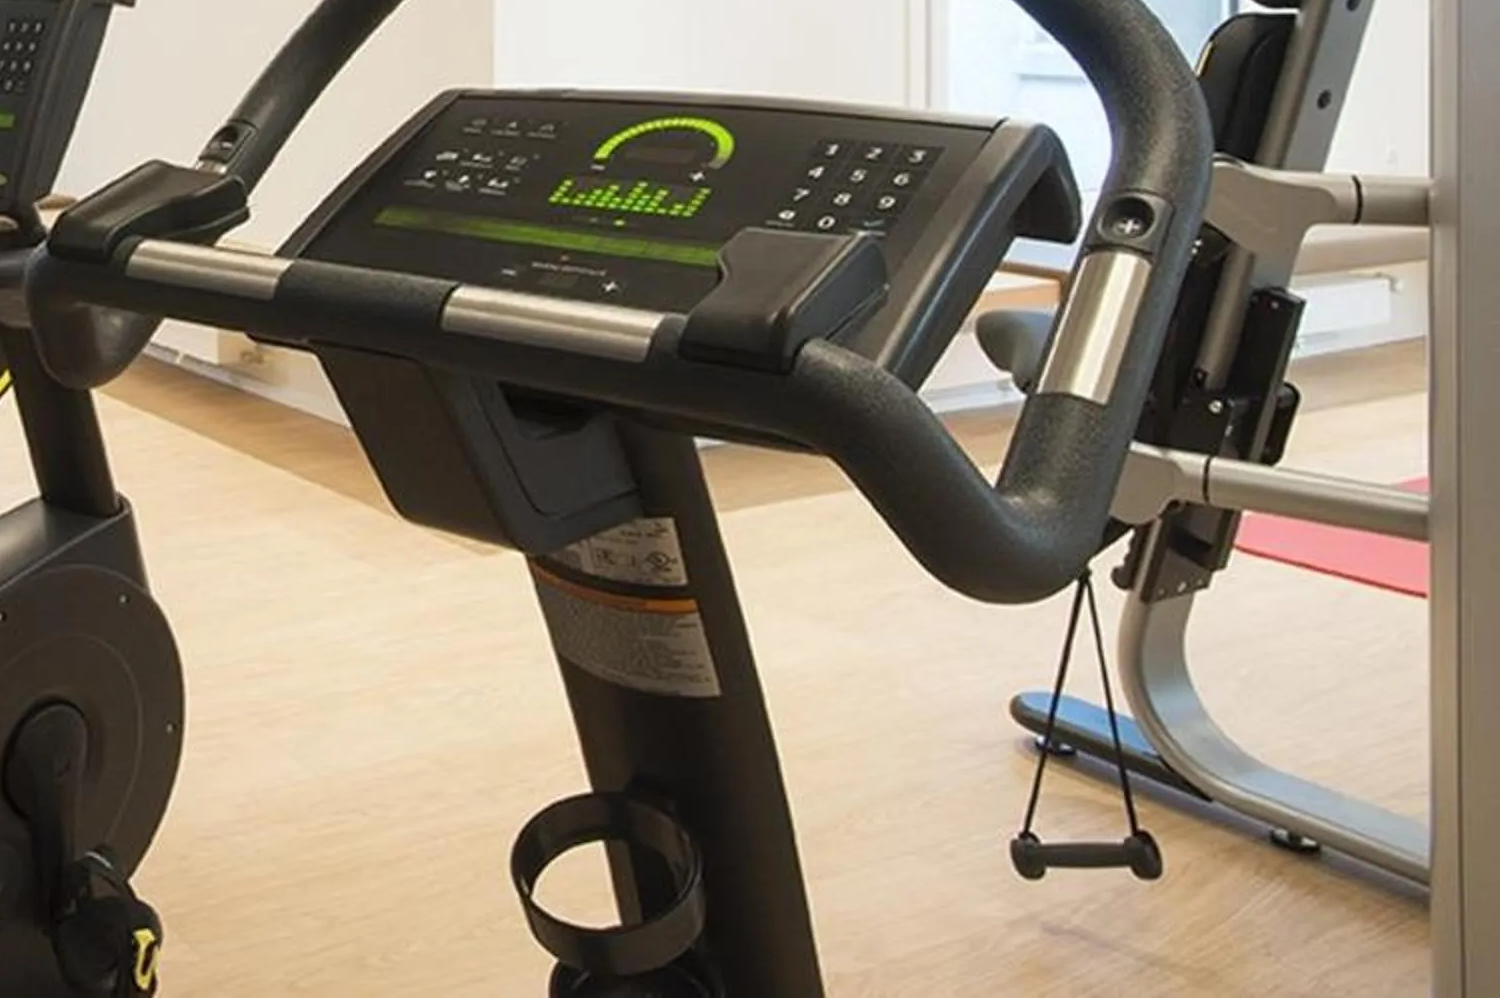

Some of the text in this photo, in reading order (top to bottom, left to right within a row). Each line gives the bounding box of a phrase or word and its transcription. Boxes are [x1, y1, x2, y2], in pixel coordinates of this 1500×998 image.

[825, 143, 927, 163] 1 2 3
[807, 166, 910, 186] 4 5 6
[793, 187, 896, 209] 7 8 9
[817, 215, 836, 229] 0
